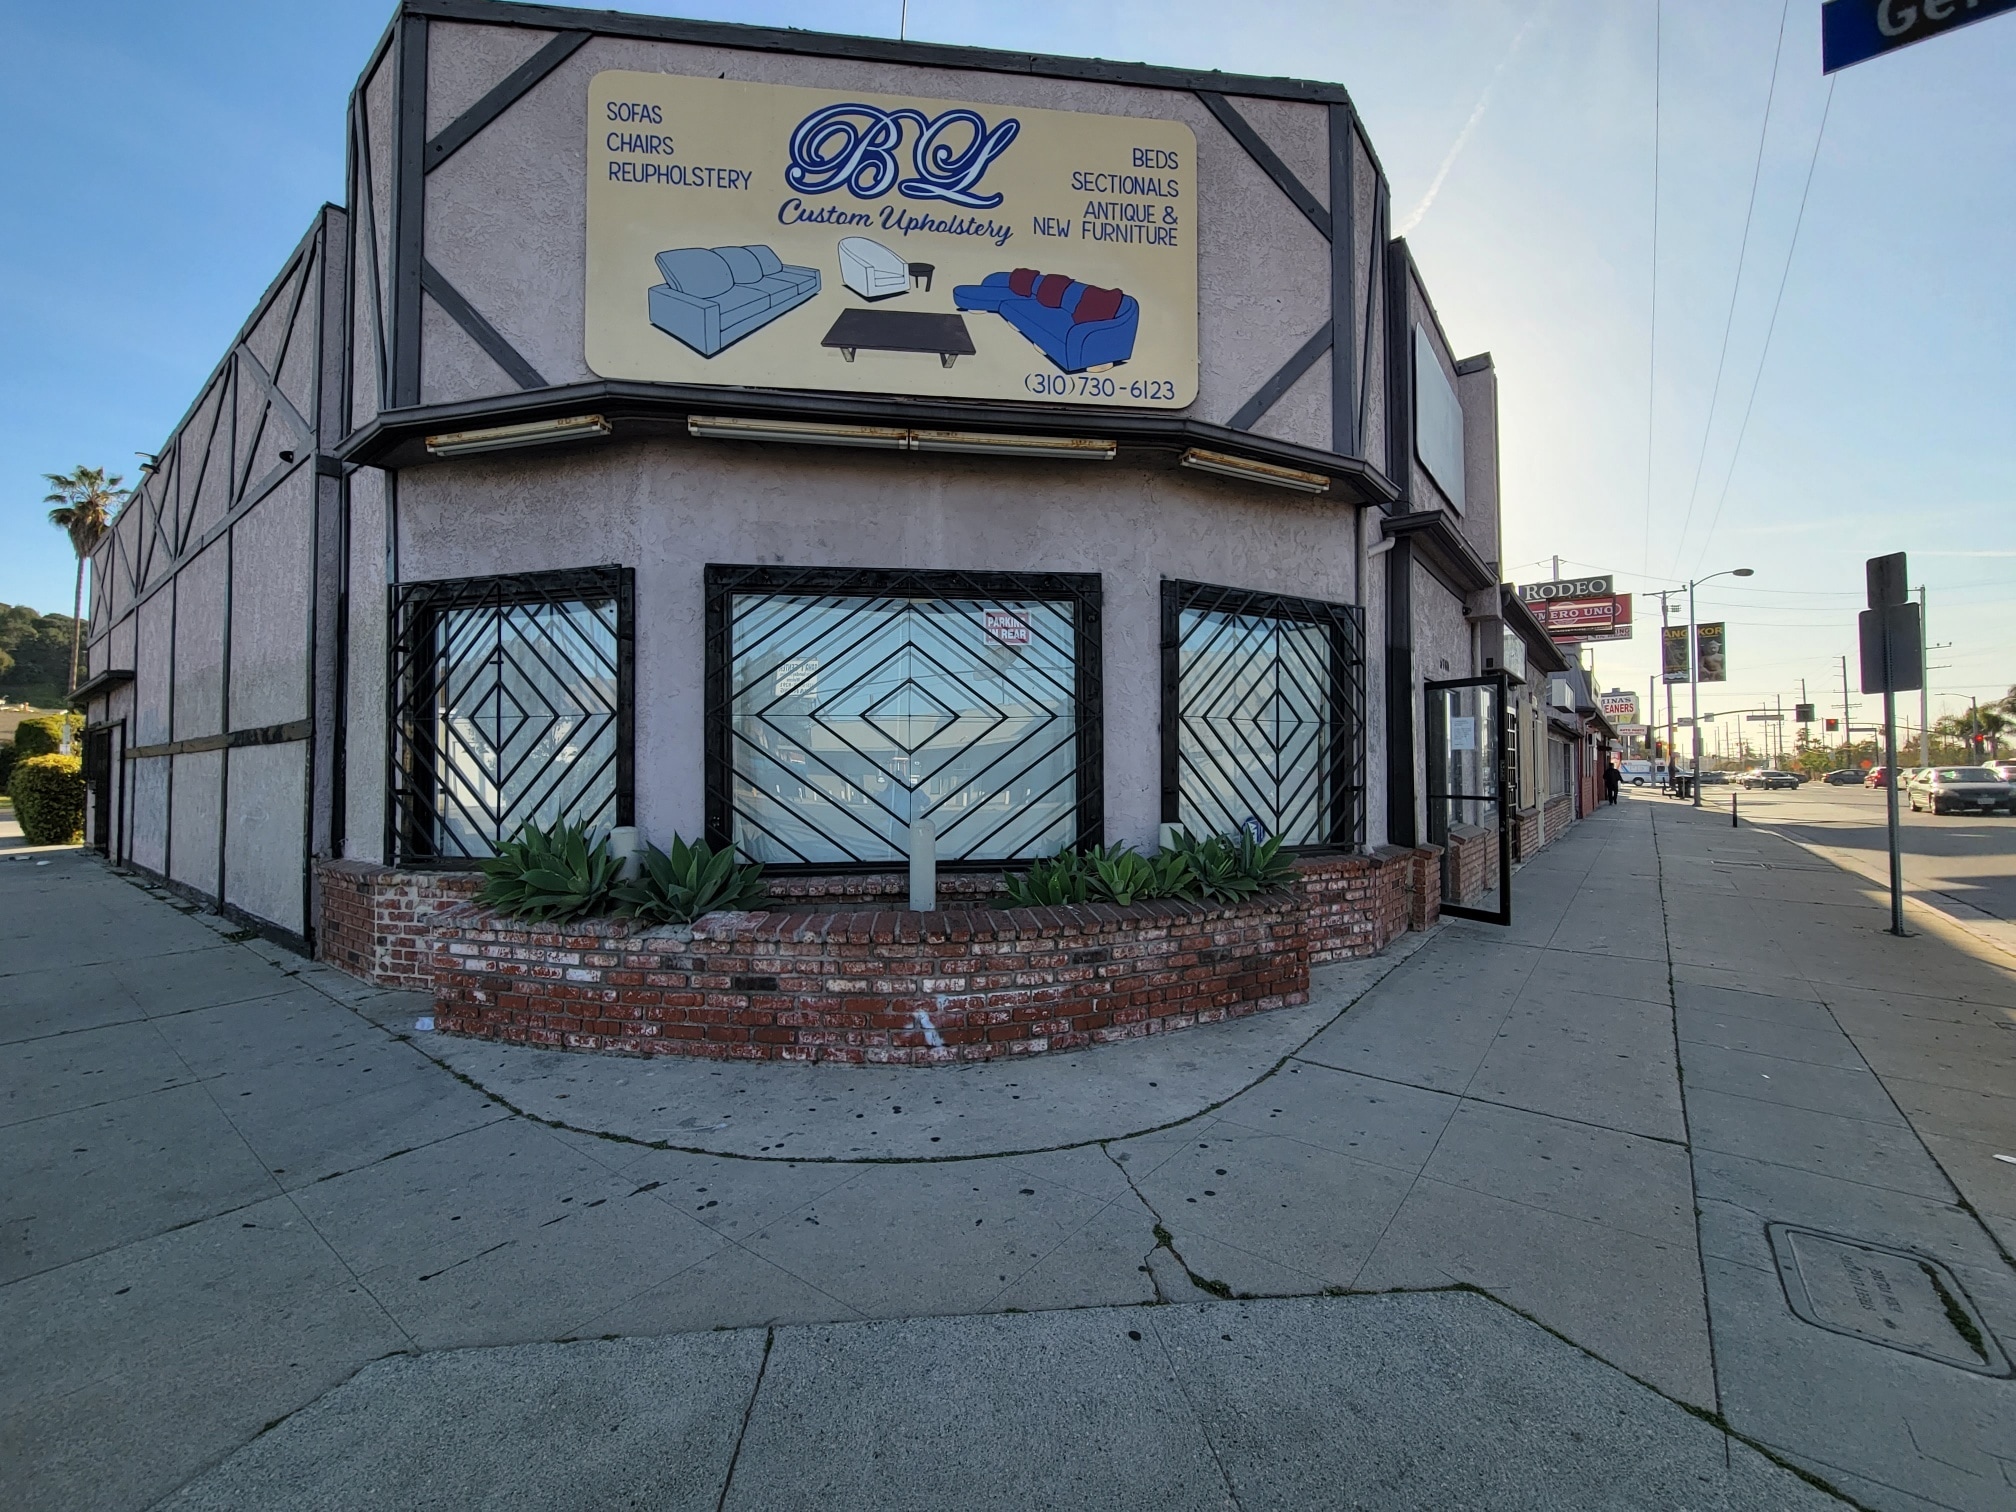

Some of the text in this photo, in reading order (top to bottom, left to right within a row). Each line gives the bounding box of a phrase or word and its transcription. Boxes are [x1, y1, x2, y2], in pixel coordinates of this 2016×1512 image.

[1877, 0, 1979, 36] Ge
[606, 101, 663, 124] SOFAS
[606, 132, 675, 156] CHAIRS
[1132, 147, 1179, 170] BEDS
[608, 161, 753, 191] REUPHOLSTERY
[1071, 171, 1179, 198] SECTIONALS
[778, 198, 1014, 247] Custom Upholstery
[1083, 200, 1179, 225] ANTIQUE &
[1033, 216, 1178, 247] NEW FURNITURE
[1024, 373, 1175, 400] (310)730-6123
[1525, 579, 1607, 601] RODEO
[1001, 629, 1027, 640] REAR
[1663, 629, 1688, 638] ANG
[1697, 626, 1723, 636] KOR
